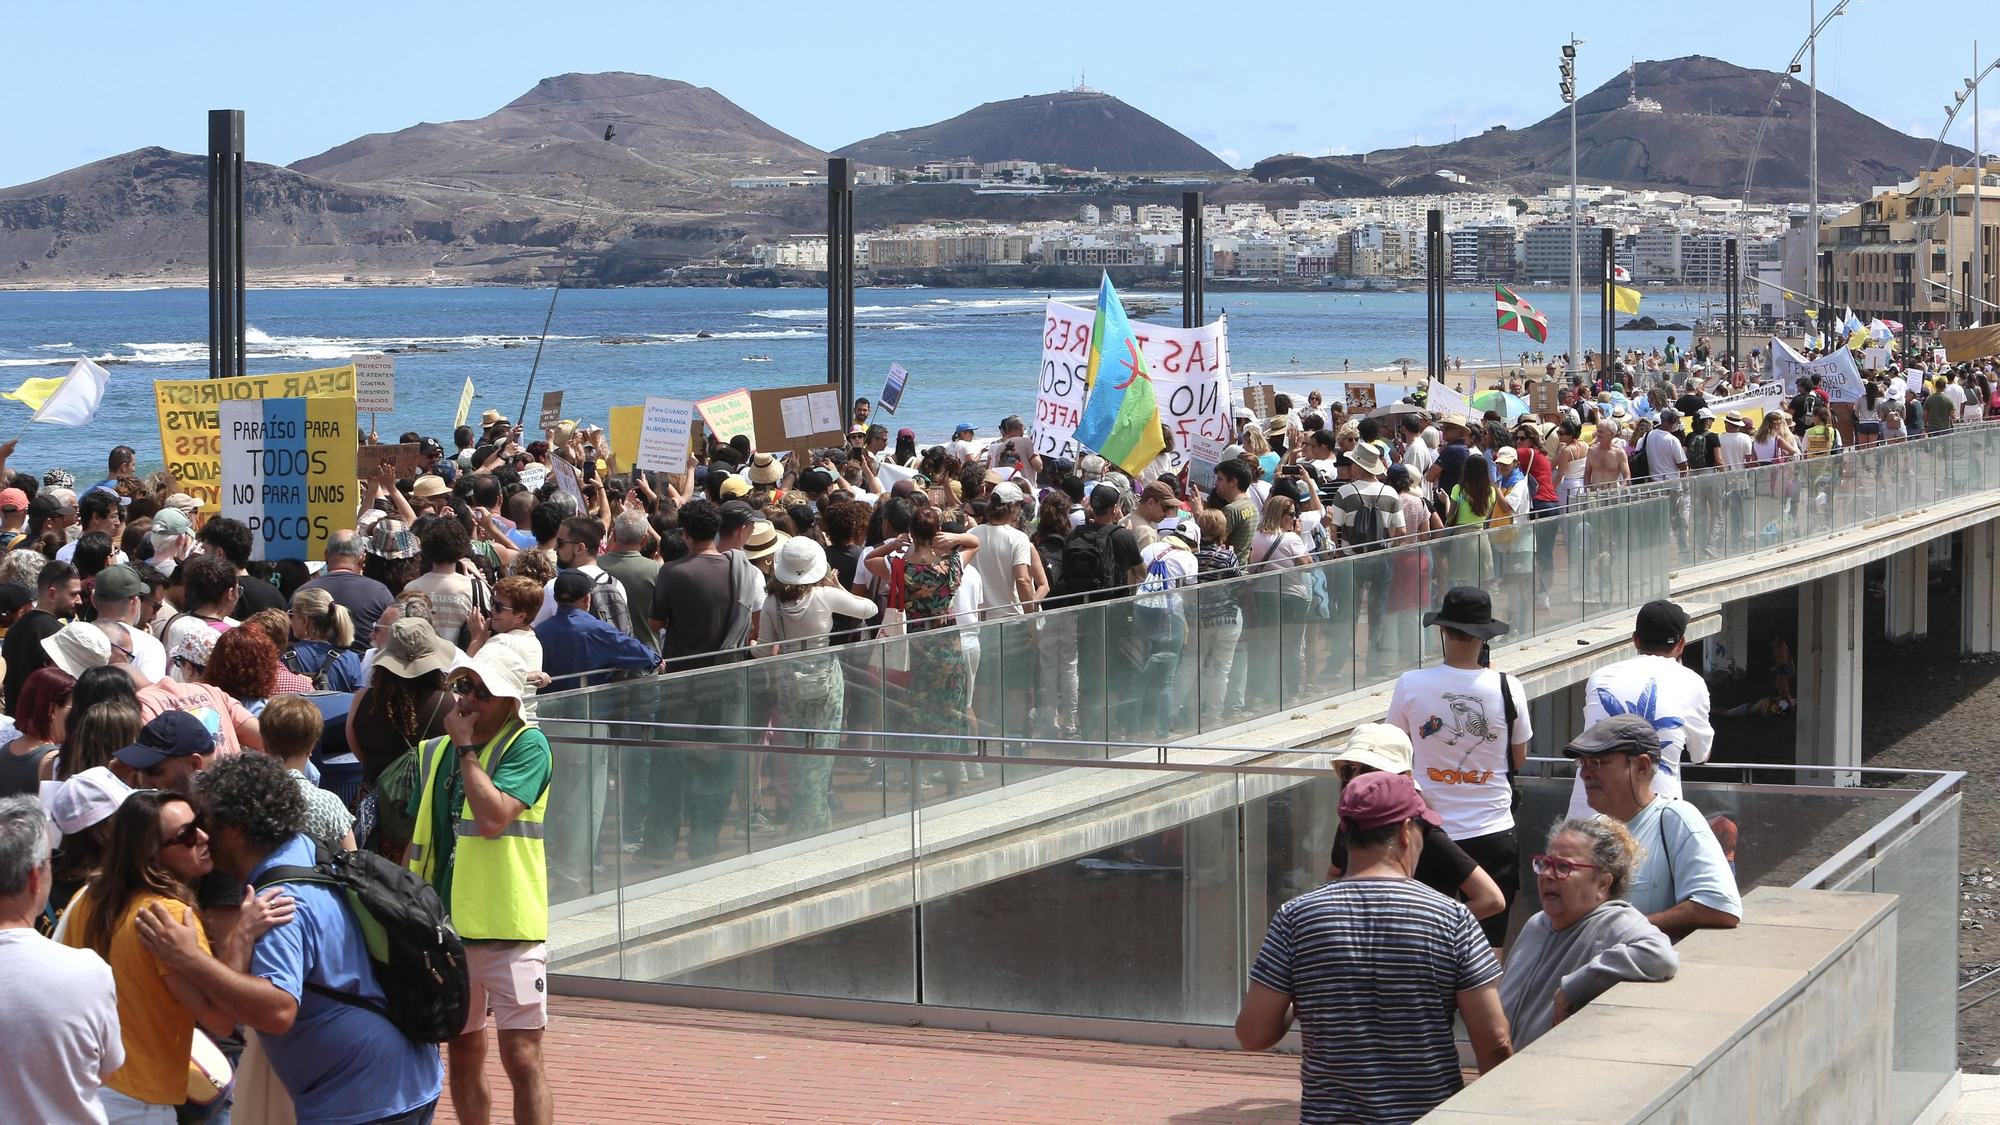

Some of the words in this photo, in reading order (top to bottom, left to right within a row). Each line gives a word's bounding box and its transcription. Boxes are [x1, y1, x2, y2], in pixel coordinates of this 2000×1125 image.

[653, 416, 686, 425] SOBERANÍA
[664, 408, 688, 416] CUÁNDO
[233, 414, 296, 441] PARAÍSO
[304, 421, 341, 439] PARA
[645, 426, 686, 435] ALIMENTARIA?
[1193, 444, 1220, 458] RENOVABLES
[246, 449, 328, 477] TODOS
[233, 484, 254, 505] NO
[261, 484, 300, 504] PARA
[307, 484, 345, 504] UNOS
[248, 515, 329, 542] POCOS
